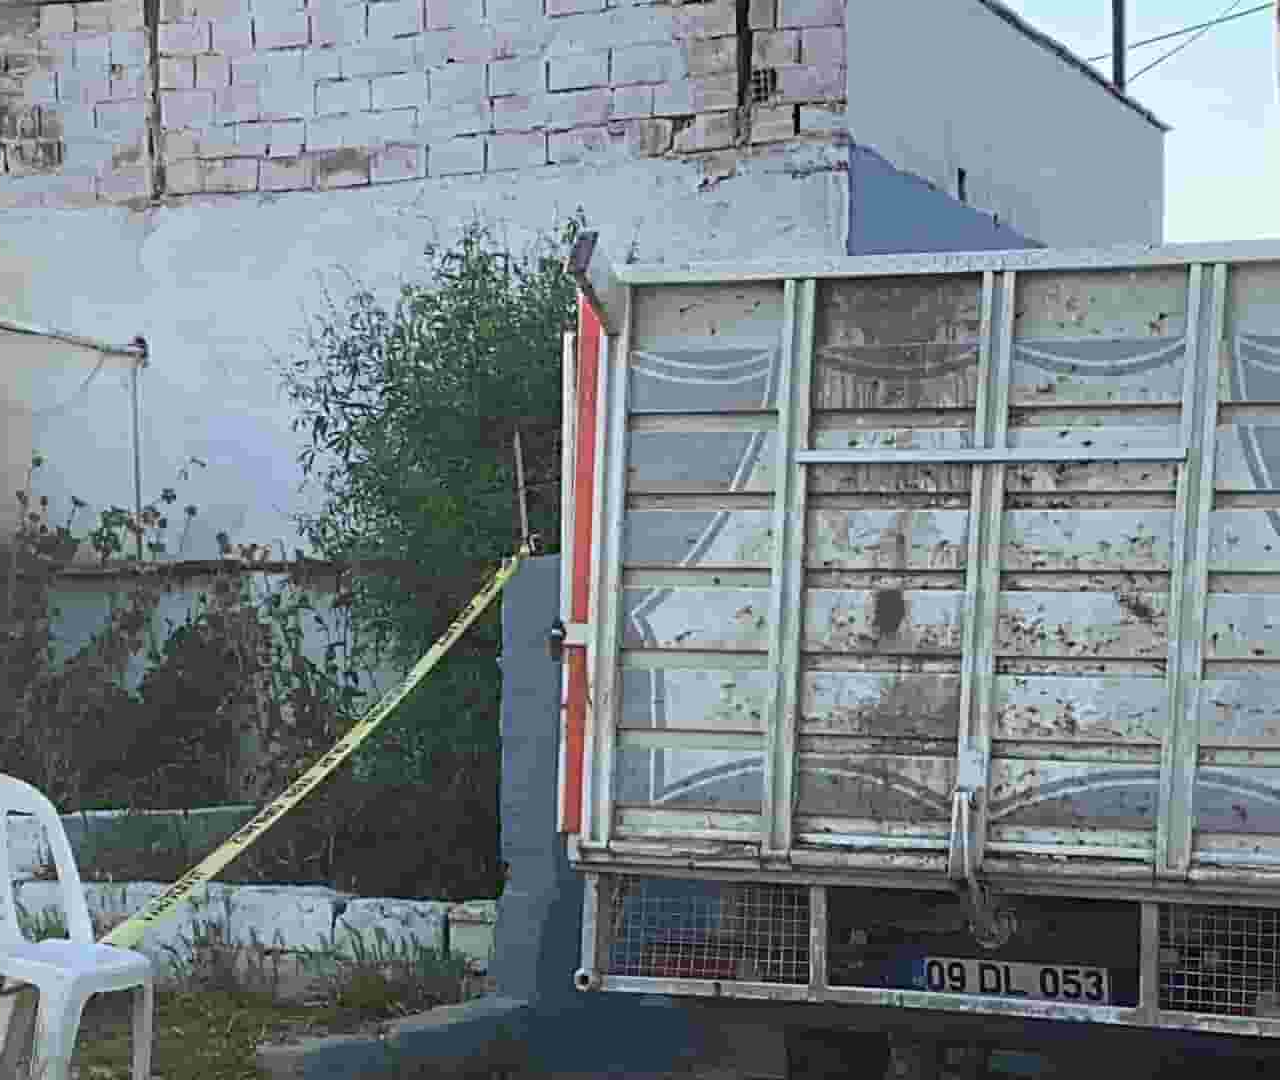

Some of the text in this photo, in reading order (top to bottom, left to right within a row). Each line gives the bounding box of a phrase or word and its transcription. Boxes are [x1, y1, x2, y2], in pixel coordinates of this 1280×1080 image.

[927, 960, 1103, 999] 09 DL 053
